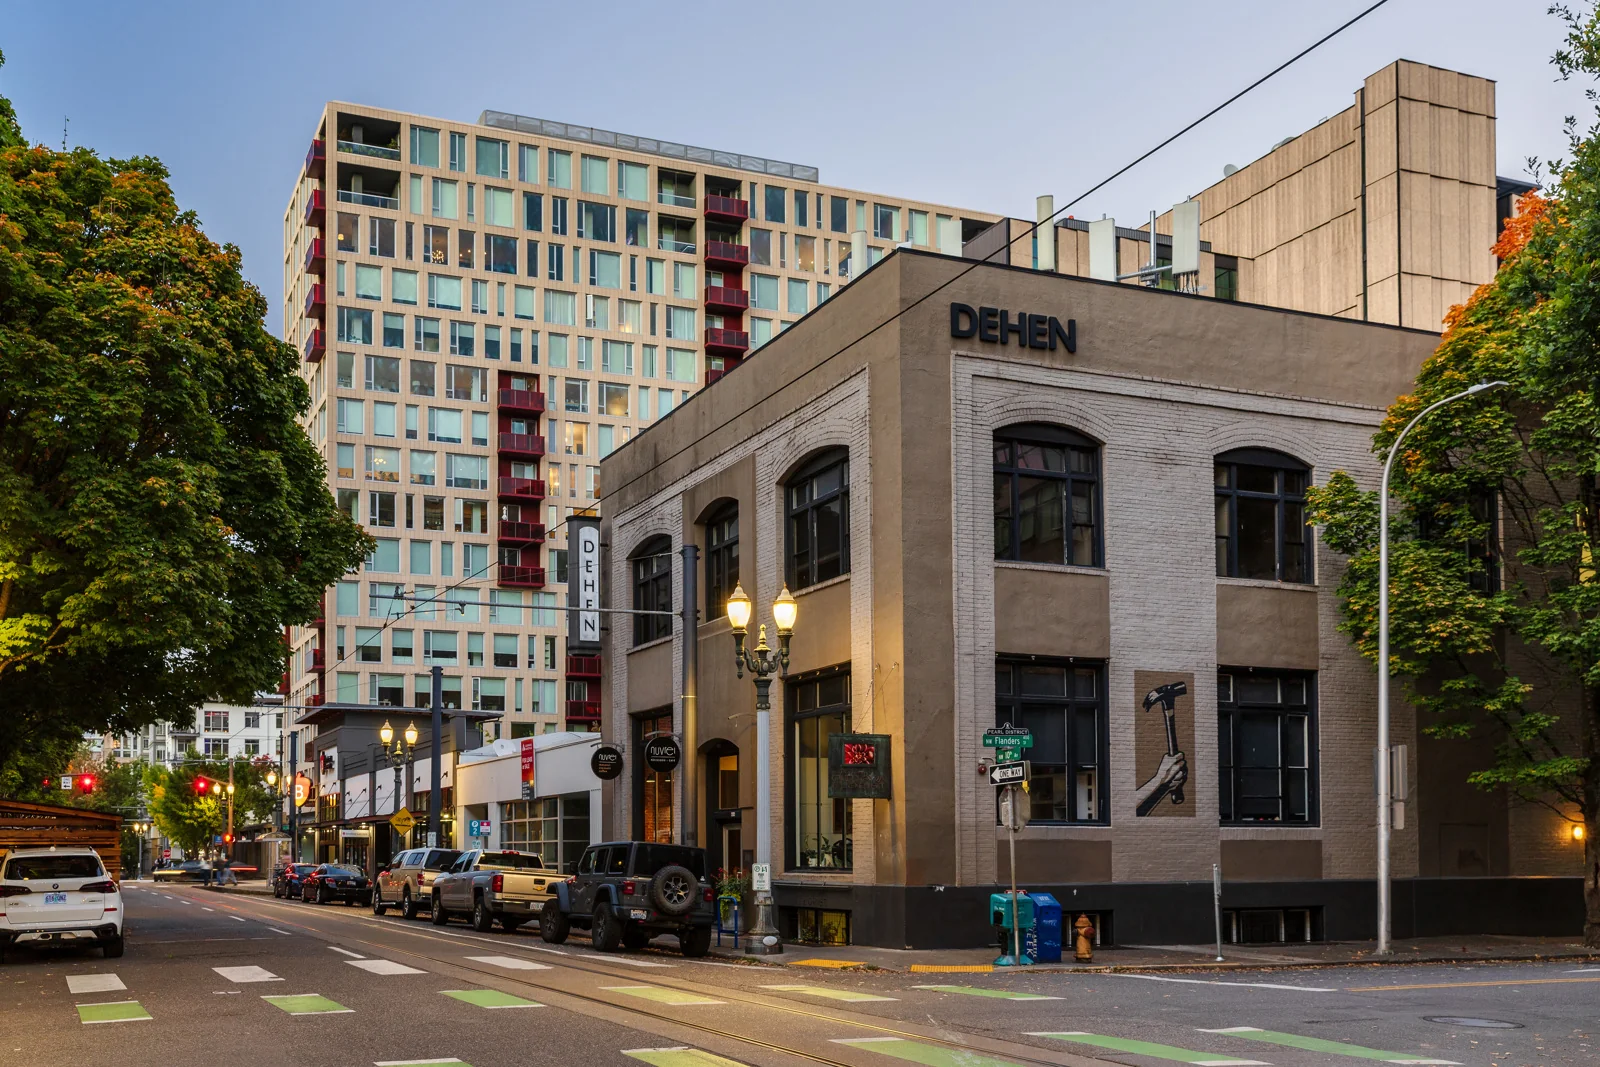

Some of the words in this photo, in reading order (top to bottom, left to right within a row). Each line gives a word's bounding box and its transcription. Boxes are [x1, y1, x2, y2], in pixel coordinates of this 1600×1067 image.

[950, 302, 1077, 353] DEHEN
[583, 540, 596, 632] DEHEN
[994, 736, 1021, 745] Flanders
[1000, 769, 1010, 778] ONE
[1010, 767, 1022, 777] WAY
[295, 785, 304, 800] B
